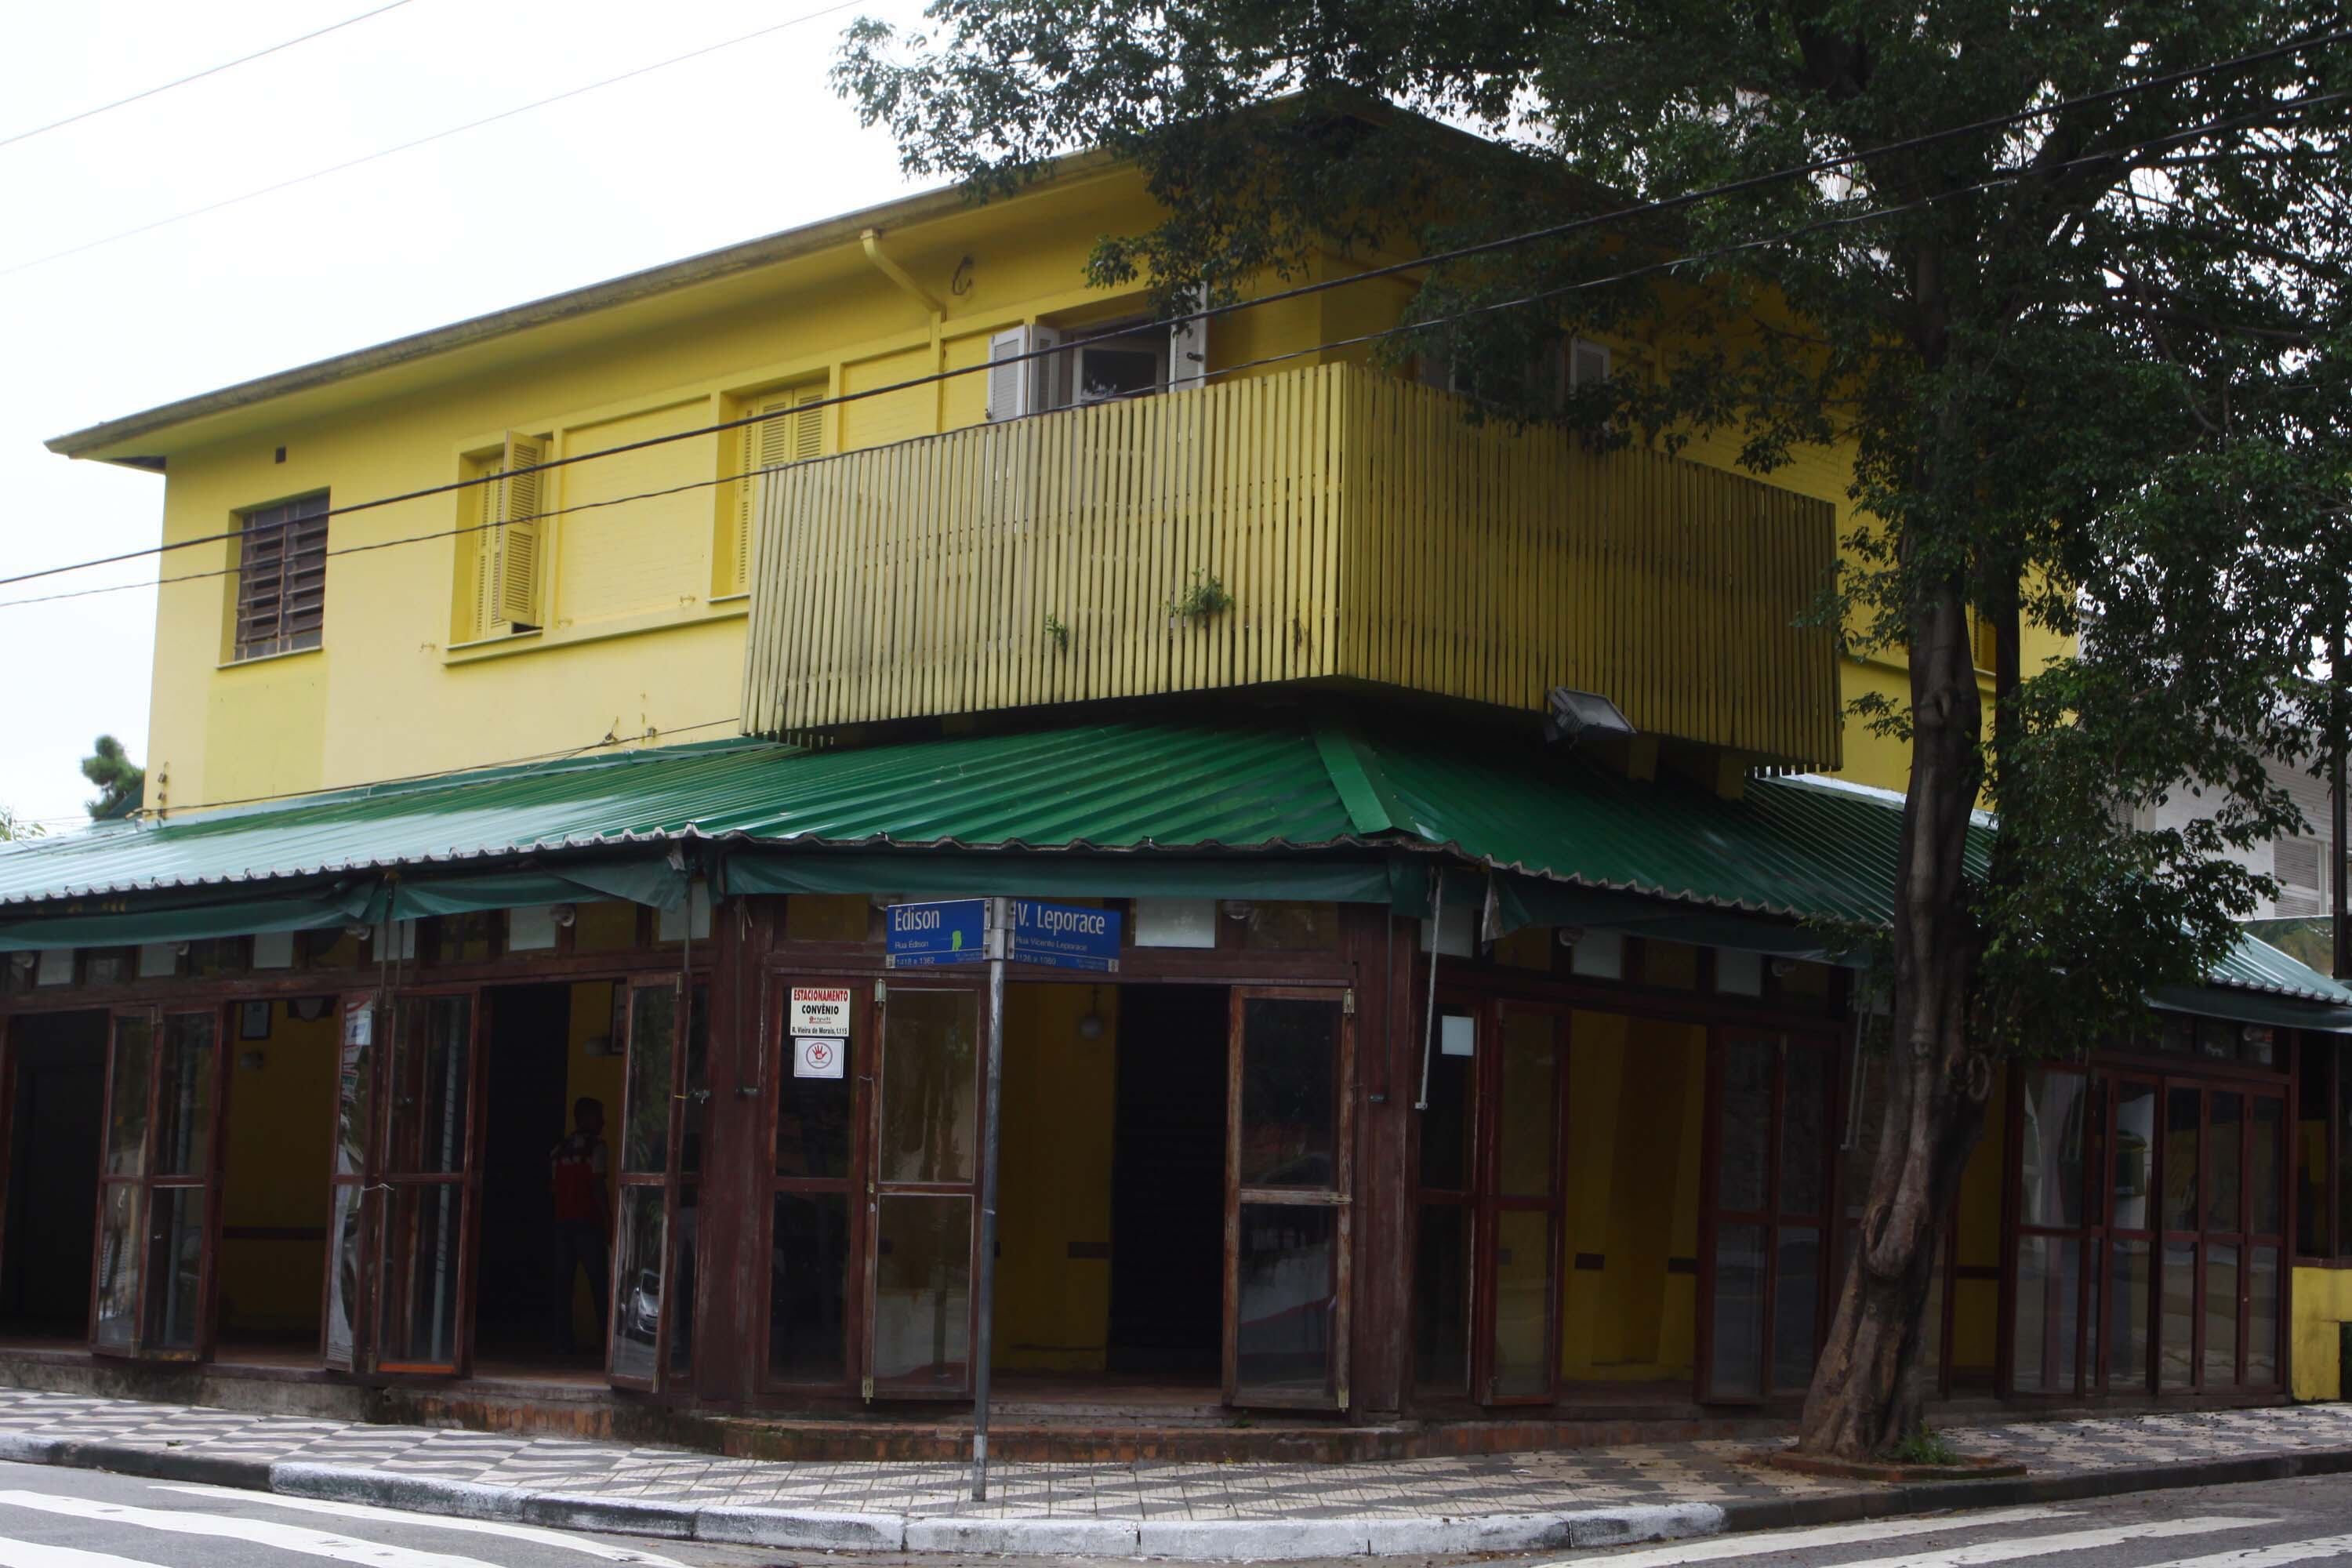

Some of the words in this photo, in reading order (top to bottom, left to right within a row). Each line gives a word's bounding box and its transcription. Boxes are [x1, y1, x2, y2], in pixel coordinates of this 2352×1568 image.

[895, 907, 939, 931] Edison
[1018, 902, 1029, 927] V.
[1037, 905, 1105, 936] Leporace
[793, 989, 848, 1001] ESTACIONAMENTO
[801, 1004, 839, 1014] CONVÊNIO
